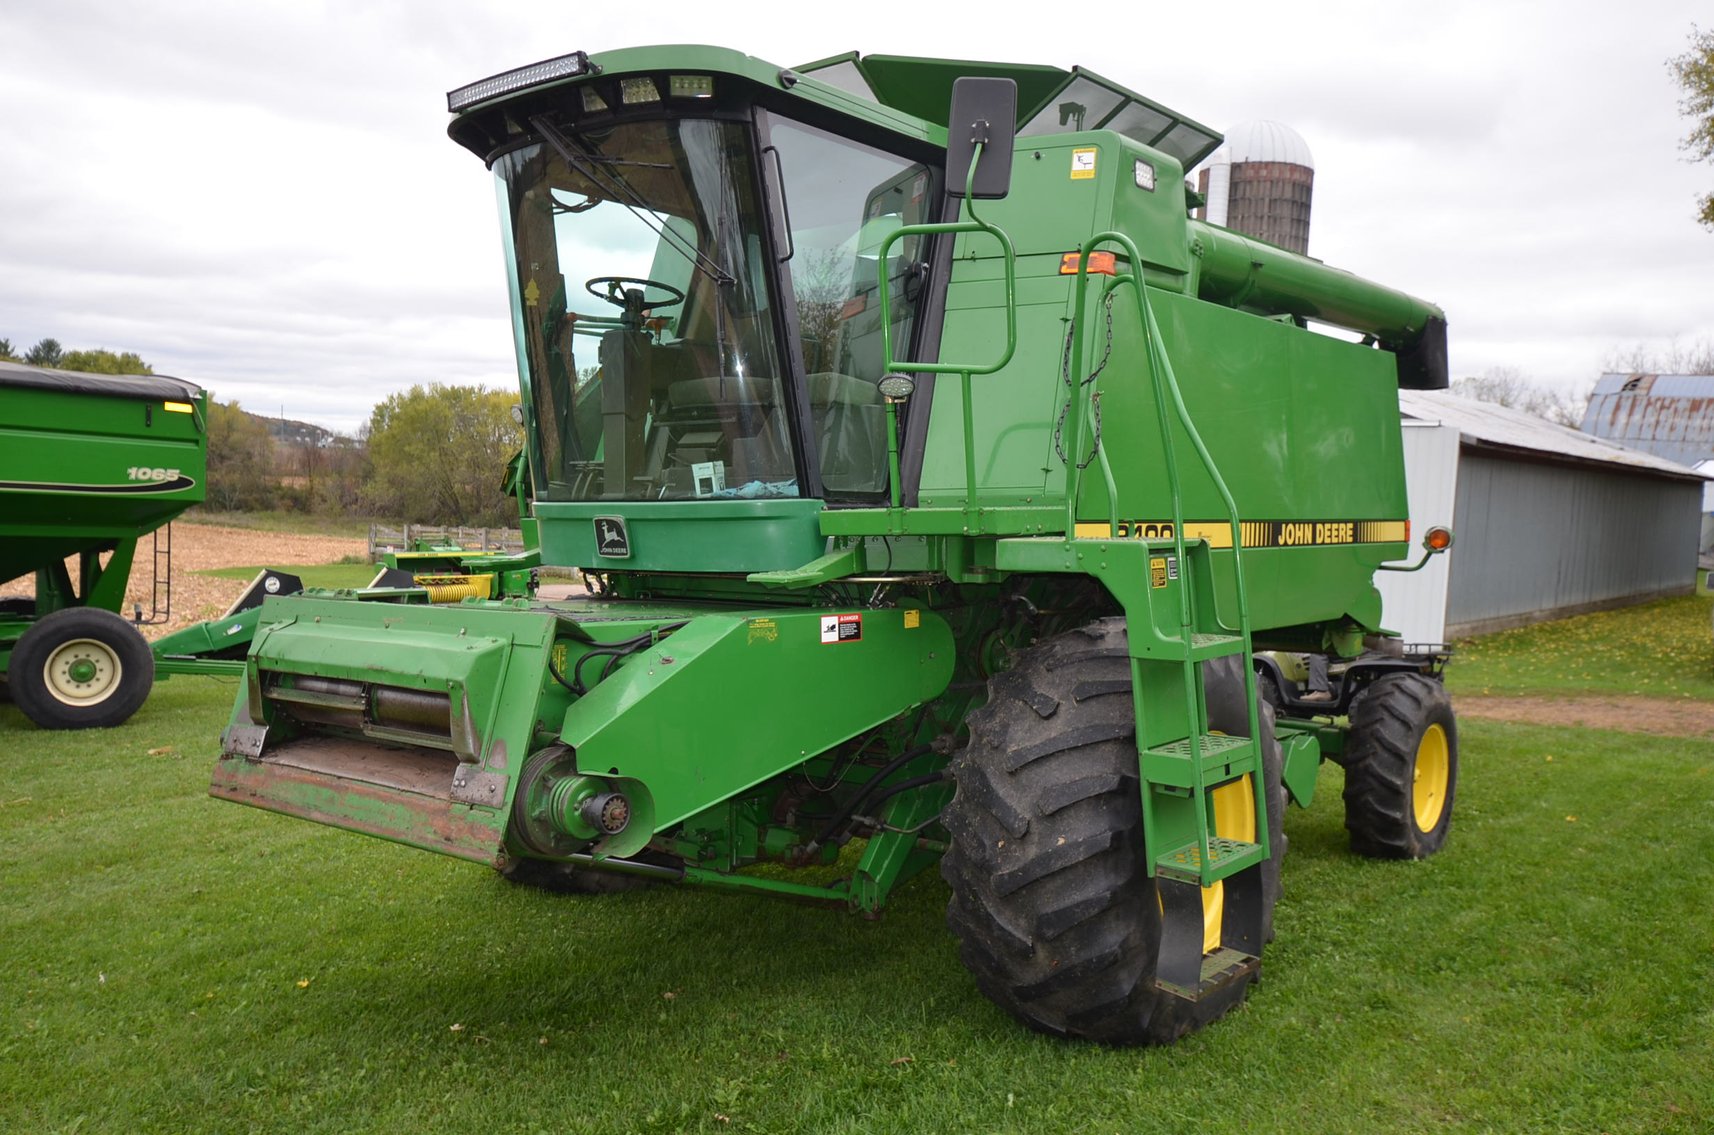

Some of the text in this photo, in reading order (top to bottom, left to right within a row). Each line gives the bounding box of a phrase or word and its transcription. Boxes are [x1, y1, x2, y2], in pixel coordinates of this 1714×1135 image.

[127, 466, 180, 481] 1065
[1278, 523, 1353, 545] JOHN DEERE
